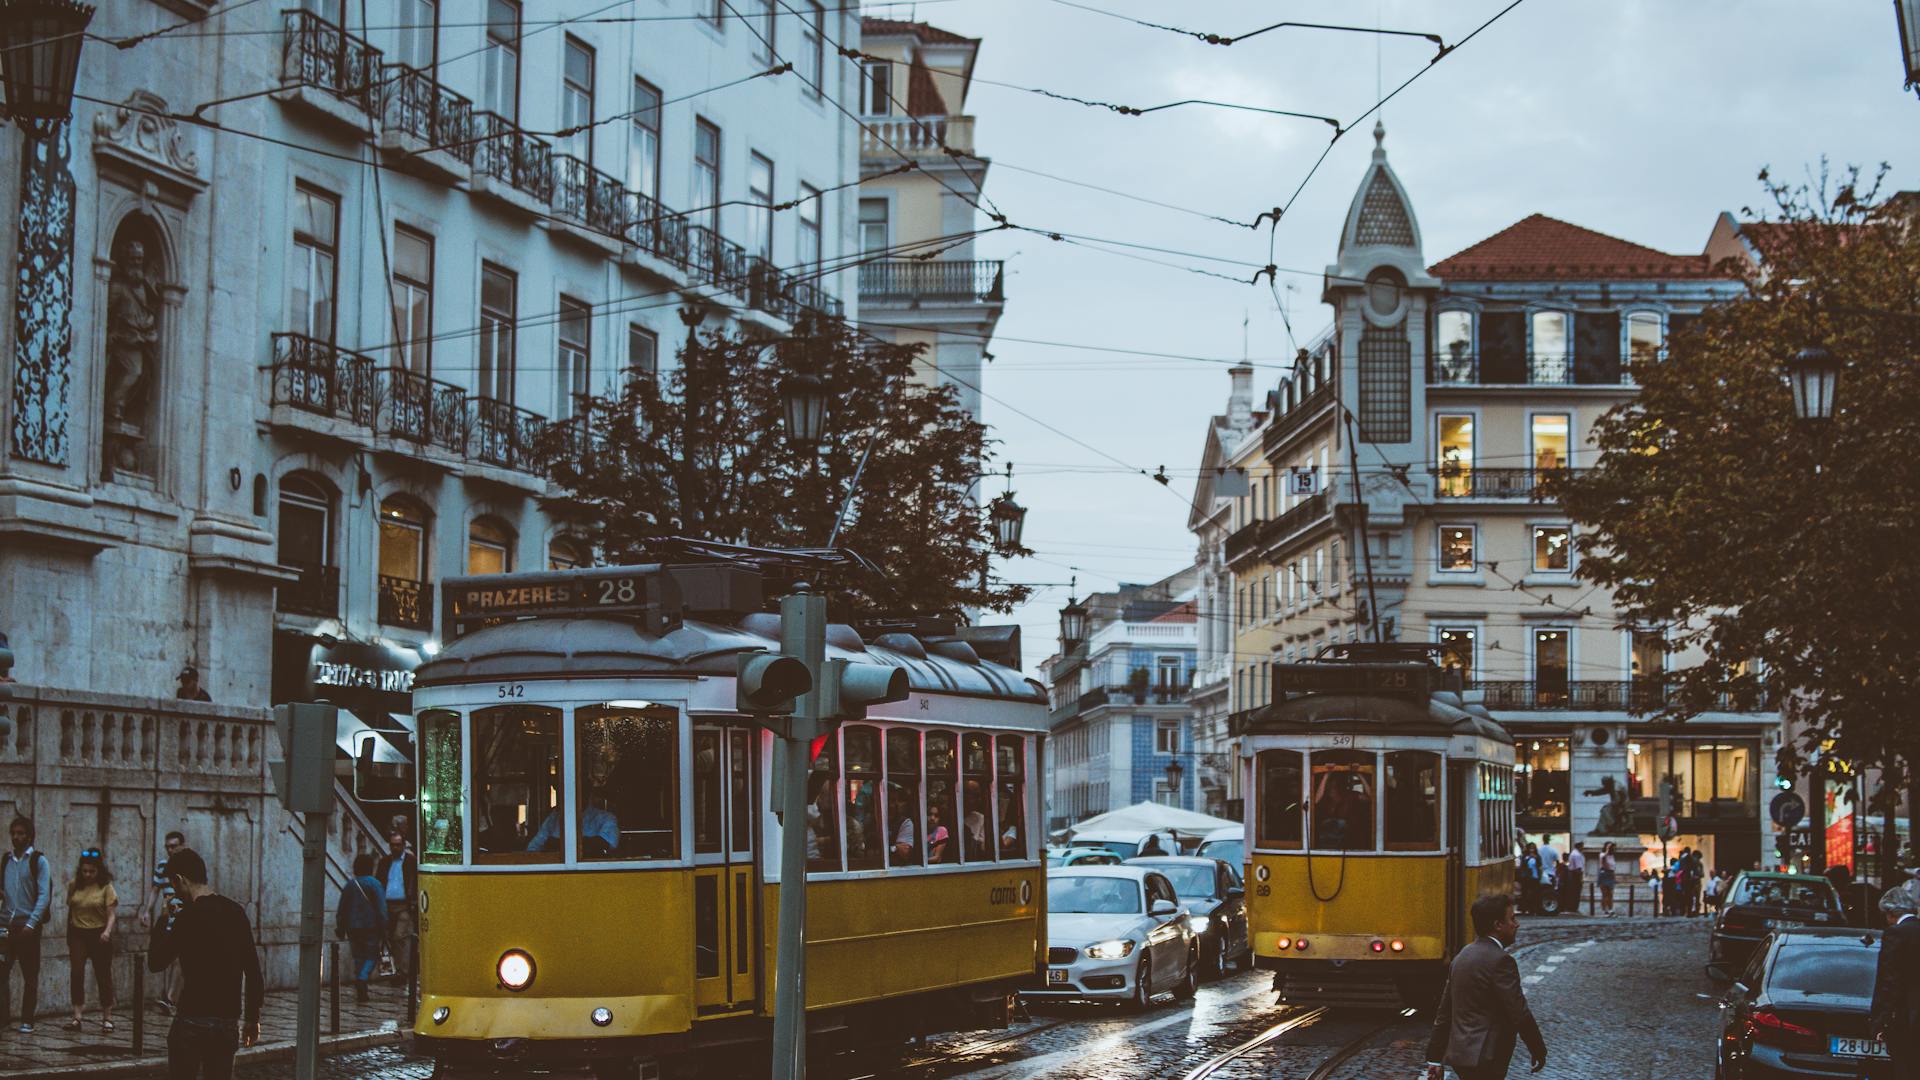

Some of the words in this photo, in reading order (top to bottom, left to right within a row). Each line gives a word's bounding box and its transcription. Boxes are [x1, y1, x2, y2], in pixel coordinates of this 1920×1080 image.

[1297, 474, 1311, 487] 15
[466, 586, 570, 608] PRAZERES
[598, 578, 636, 604] 28
[1380, 672, 1407, 688] 28
[498, 685, 524, 698] 542
[1333, 737, 1350, 746] 549
[990, 886, 1016, 905] carris
